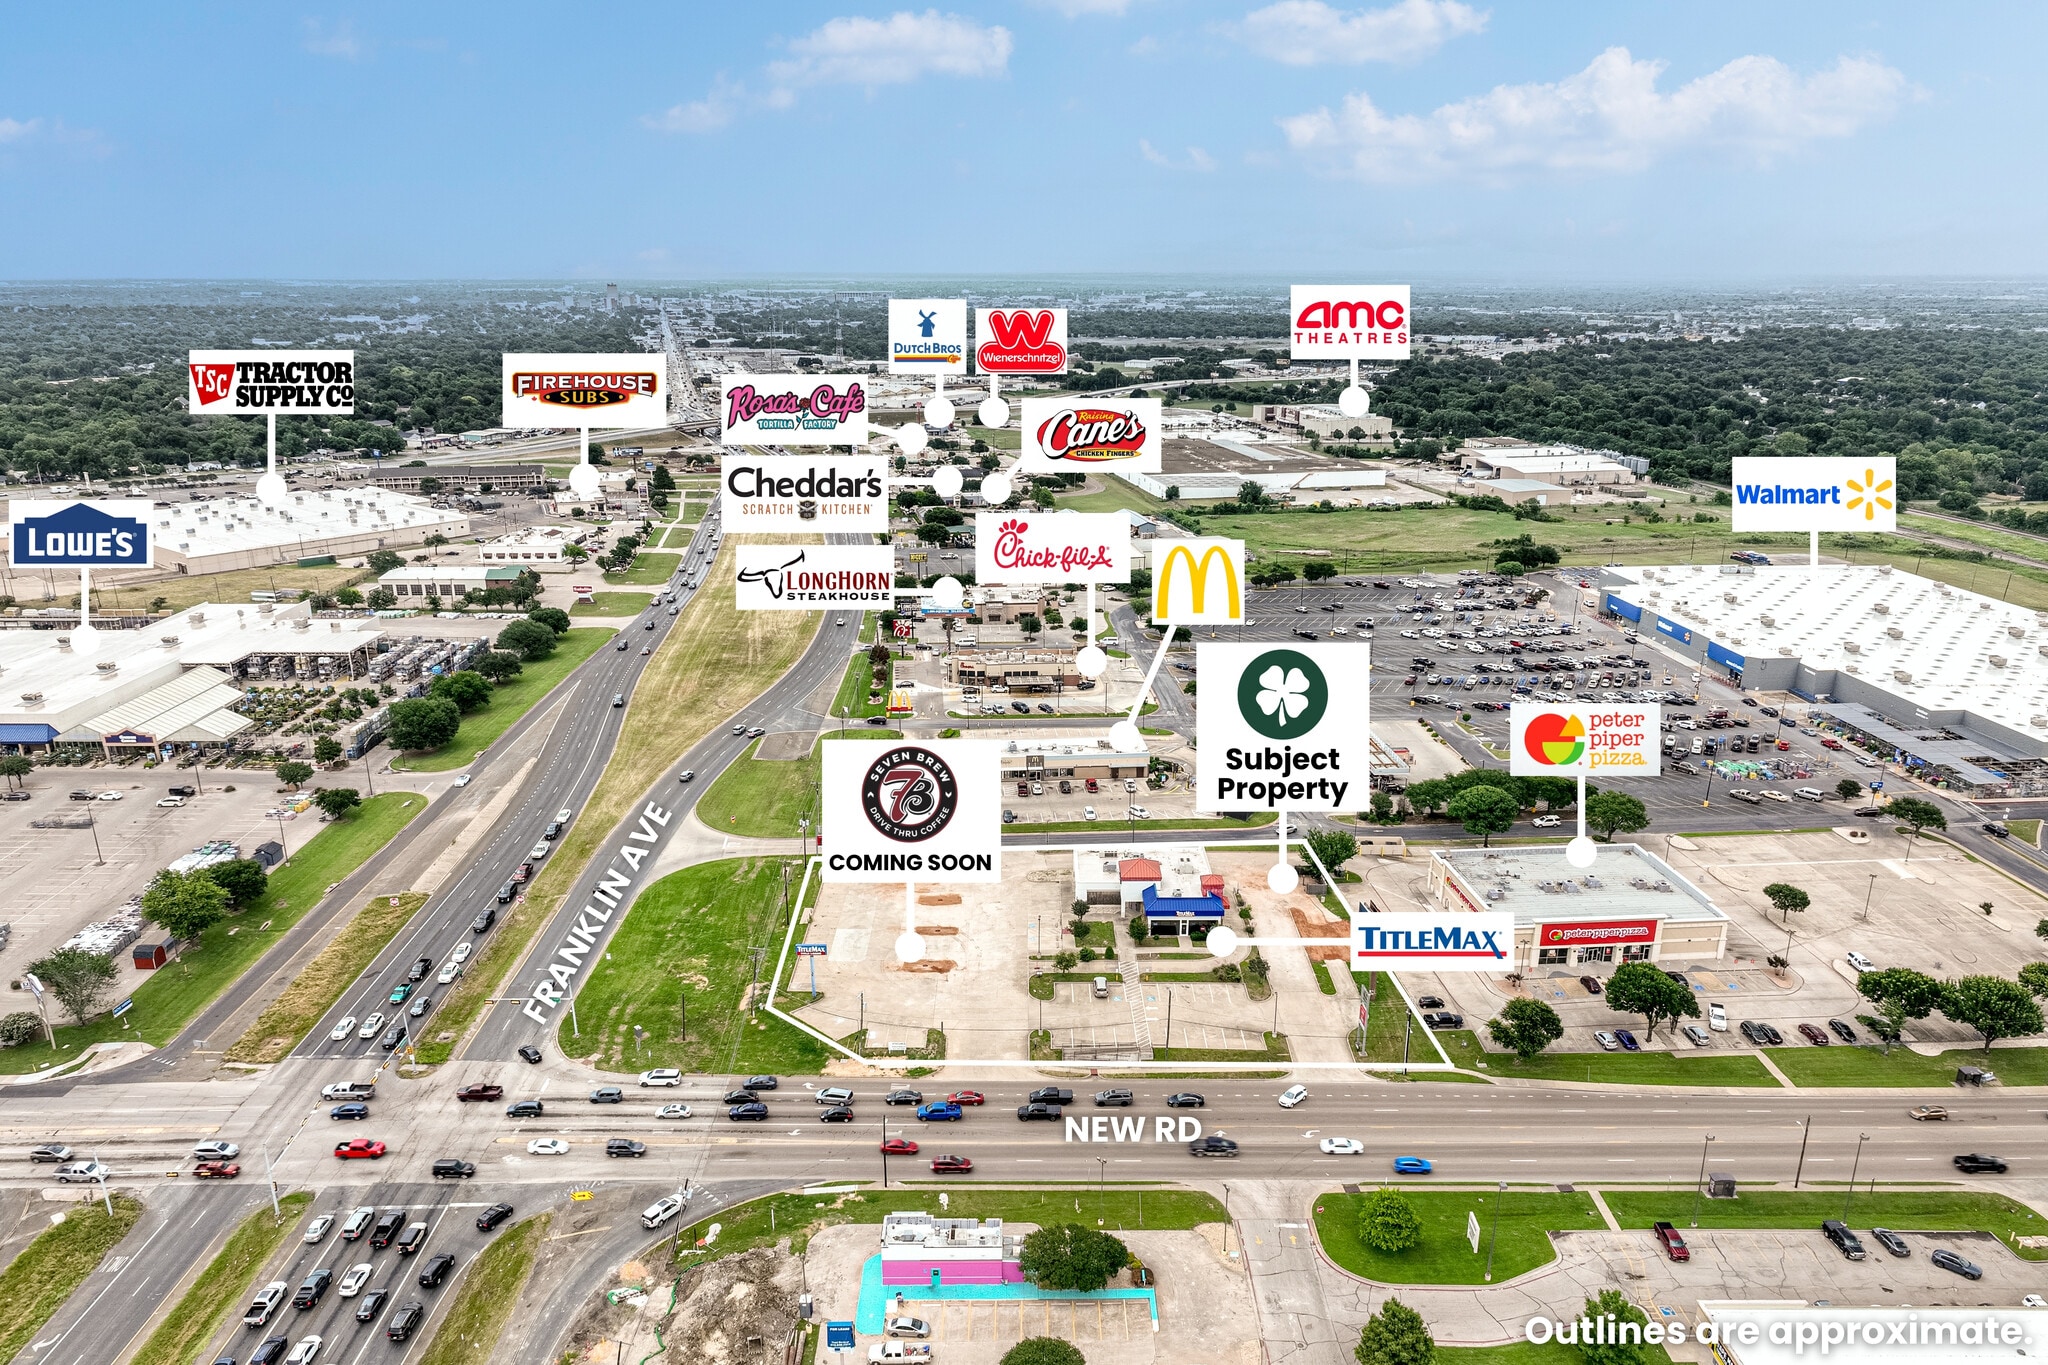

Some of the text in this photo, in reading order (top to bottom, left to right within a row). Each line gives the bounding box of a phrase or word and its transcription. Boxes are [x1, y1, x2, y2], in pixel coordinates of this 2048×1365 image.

[1563, 927, 1648, 940] peter piper pizza
